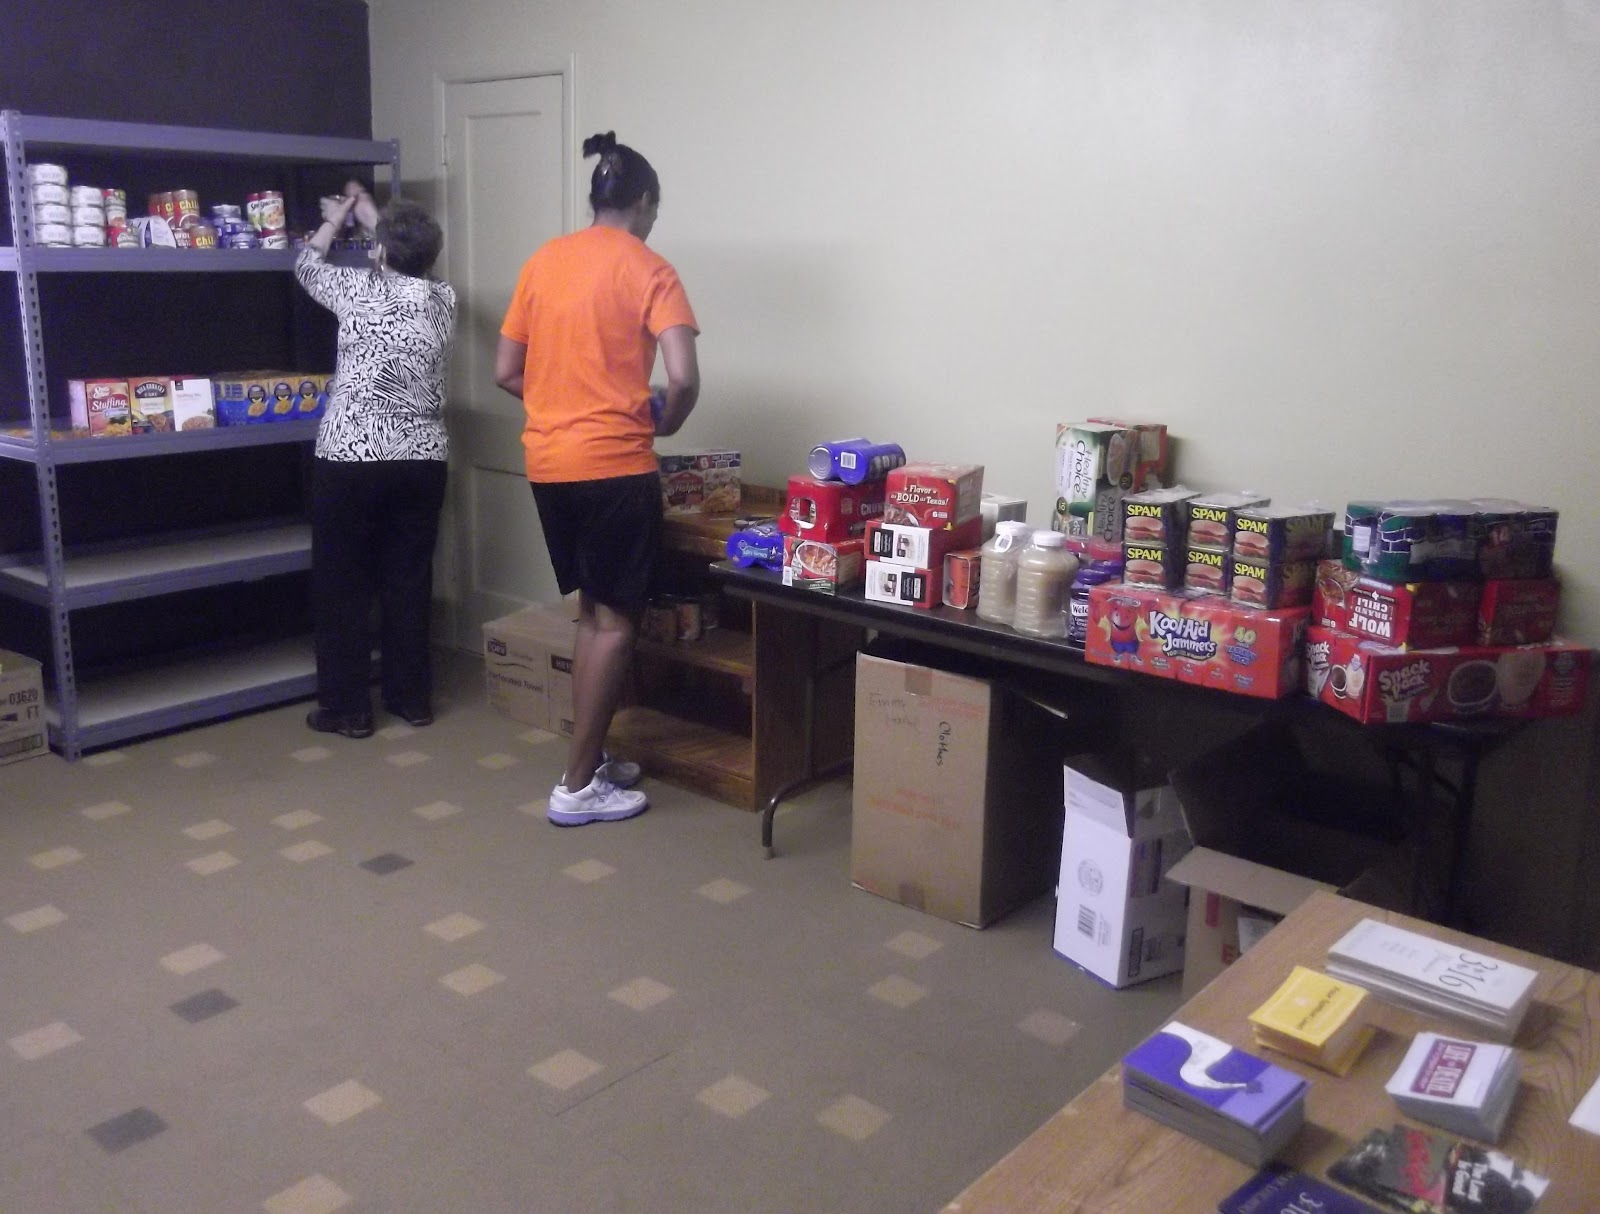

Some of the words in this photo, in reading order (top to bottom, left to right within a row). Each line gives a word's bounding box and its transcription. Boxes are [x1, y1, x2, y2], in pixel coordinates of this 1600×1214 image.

[92, 397, 128, 411] Stuffing
[1073, 440, 1086, 493] Choice
[1081, 449, 1093, 499] Healthy
[909, 484, 932, 494] Flavor
[896, 493, 920, 503] BOLD
[926, 496, 949, 506] Texas!
[860, 502, 884, 516] CHUN
[1127, 504, 1162, 518] SPAM
[1191, 507, 1226, 522] SPAM
[1103, 496, 1116, 542] Choice
[1236, 518, 1268, 534] SPAM
[1127, 548, 1162, 561] SPAM
[1187, 551, 1222, 567] SPAM
[1234, 563, 1266, 580] SPAM
[1072, 605, 1089, 614] Welc
[1356, 597, 1388, 612] CHILI
[1354, 606, 1388, 621] BRAND
[1348, 612, 1391, 638] WOLF
[1162, 633, 1217, 653] Jammers
[1379, 659, 1431, 691] Snack
[935, 720, 951, 767] Clothes
